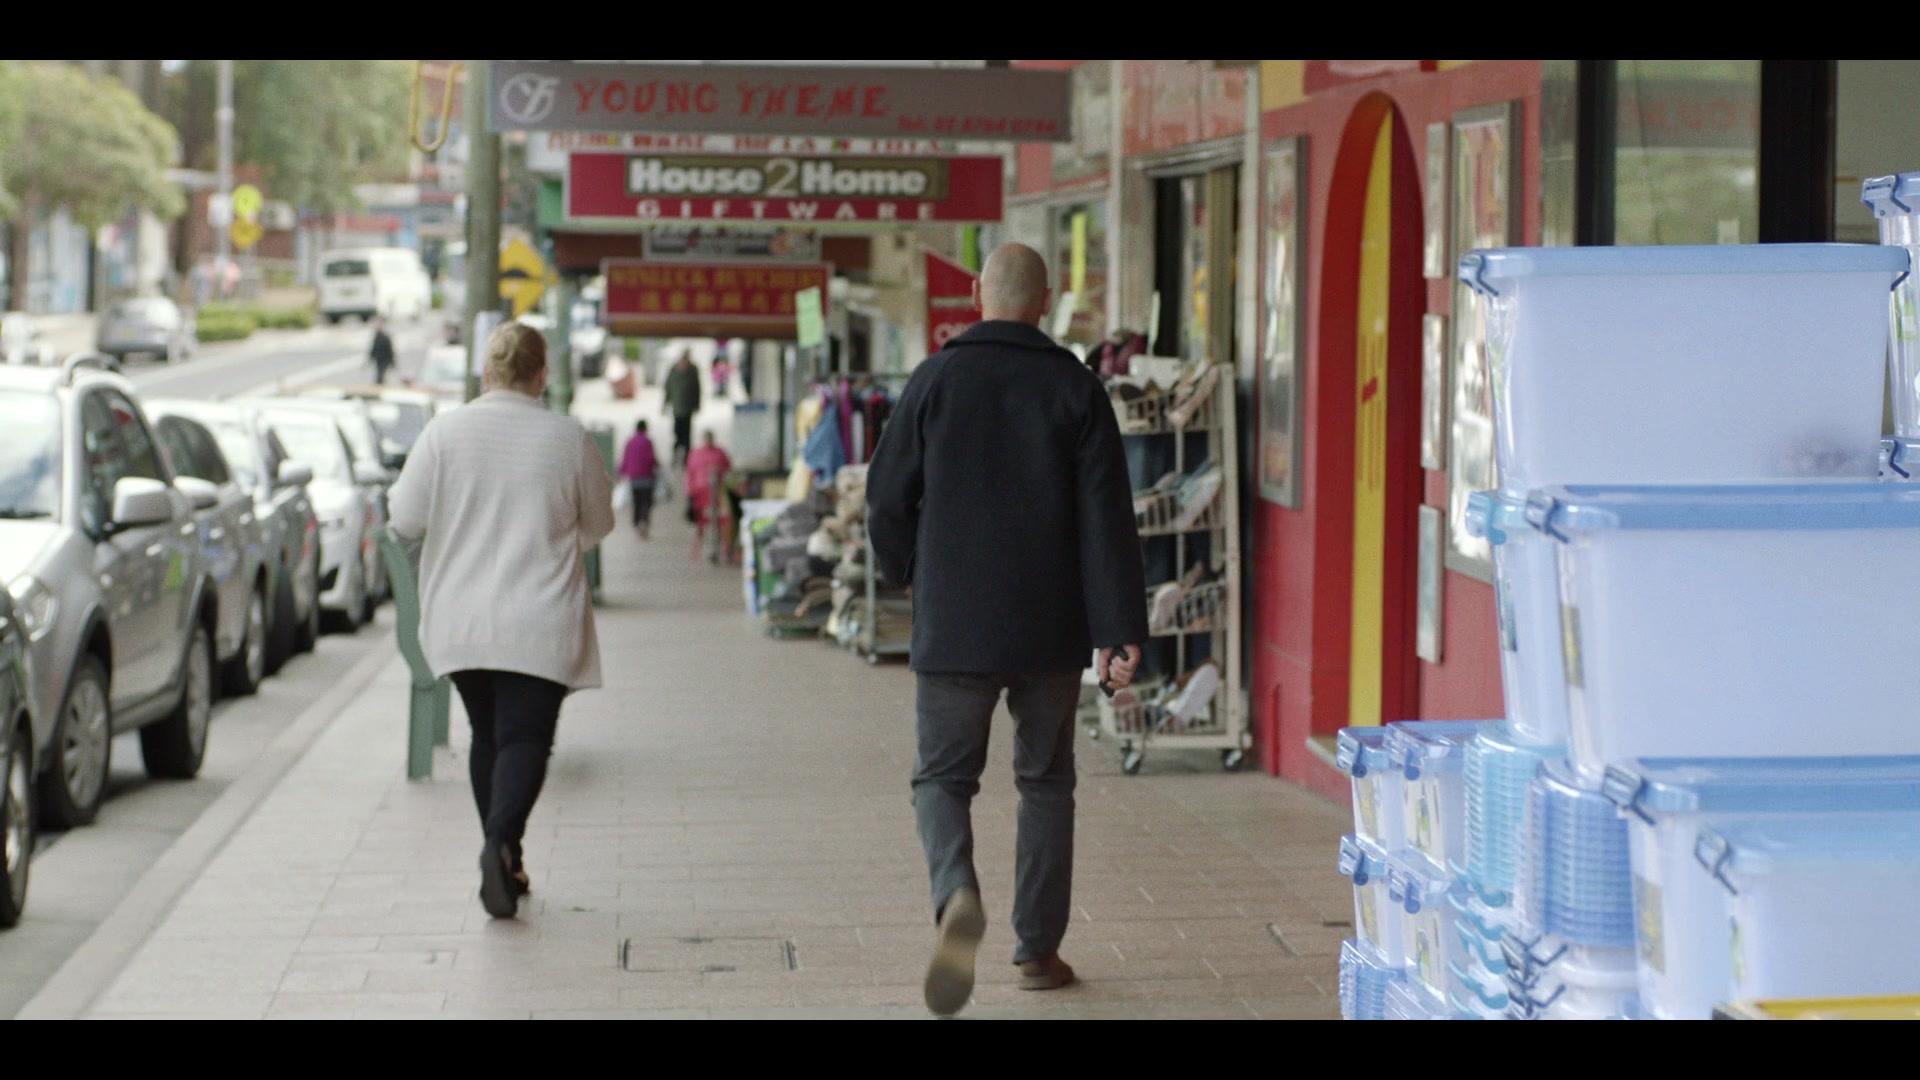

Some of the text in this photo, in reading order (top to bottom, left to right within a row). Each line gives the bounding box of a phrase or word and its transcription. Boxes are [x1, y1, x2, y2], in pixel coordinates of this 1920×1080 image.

[570, 79, 890, 119] YOUNG THEME
[636, 200, 935, 219] GIFTWARE
